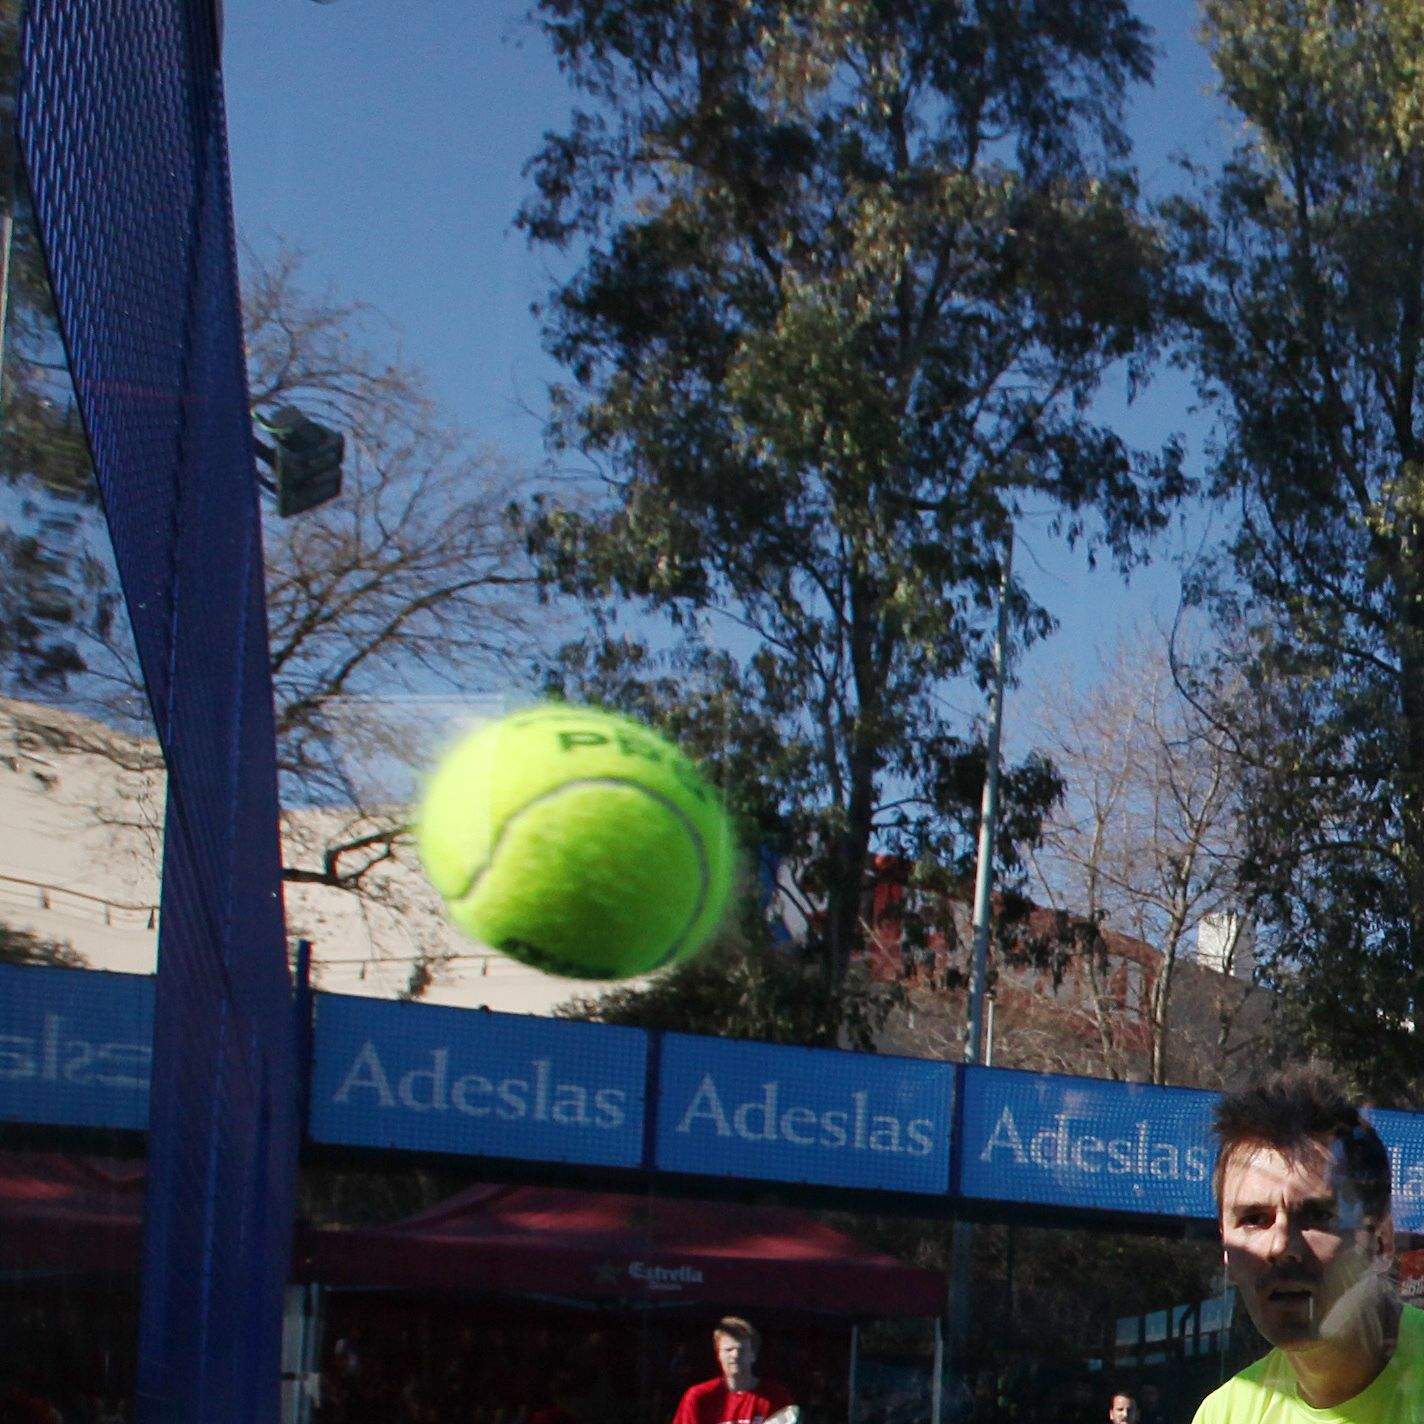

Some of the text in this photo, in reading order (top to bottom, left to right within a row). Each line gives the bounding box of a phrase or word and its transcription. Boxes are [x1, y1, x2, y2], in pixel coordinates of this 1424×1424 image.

[333, 1039, 626, 1129] Adeslas
[676, 1072, 935, 1157] Adeslas
[980, 1105, 1206, 1182] Adeslas
[629, 1260, 703, 1284] Estrella
